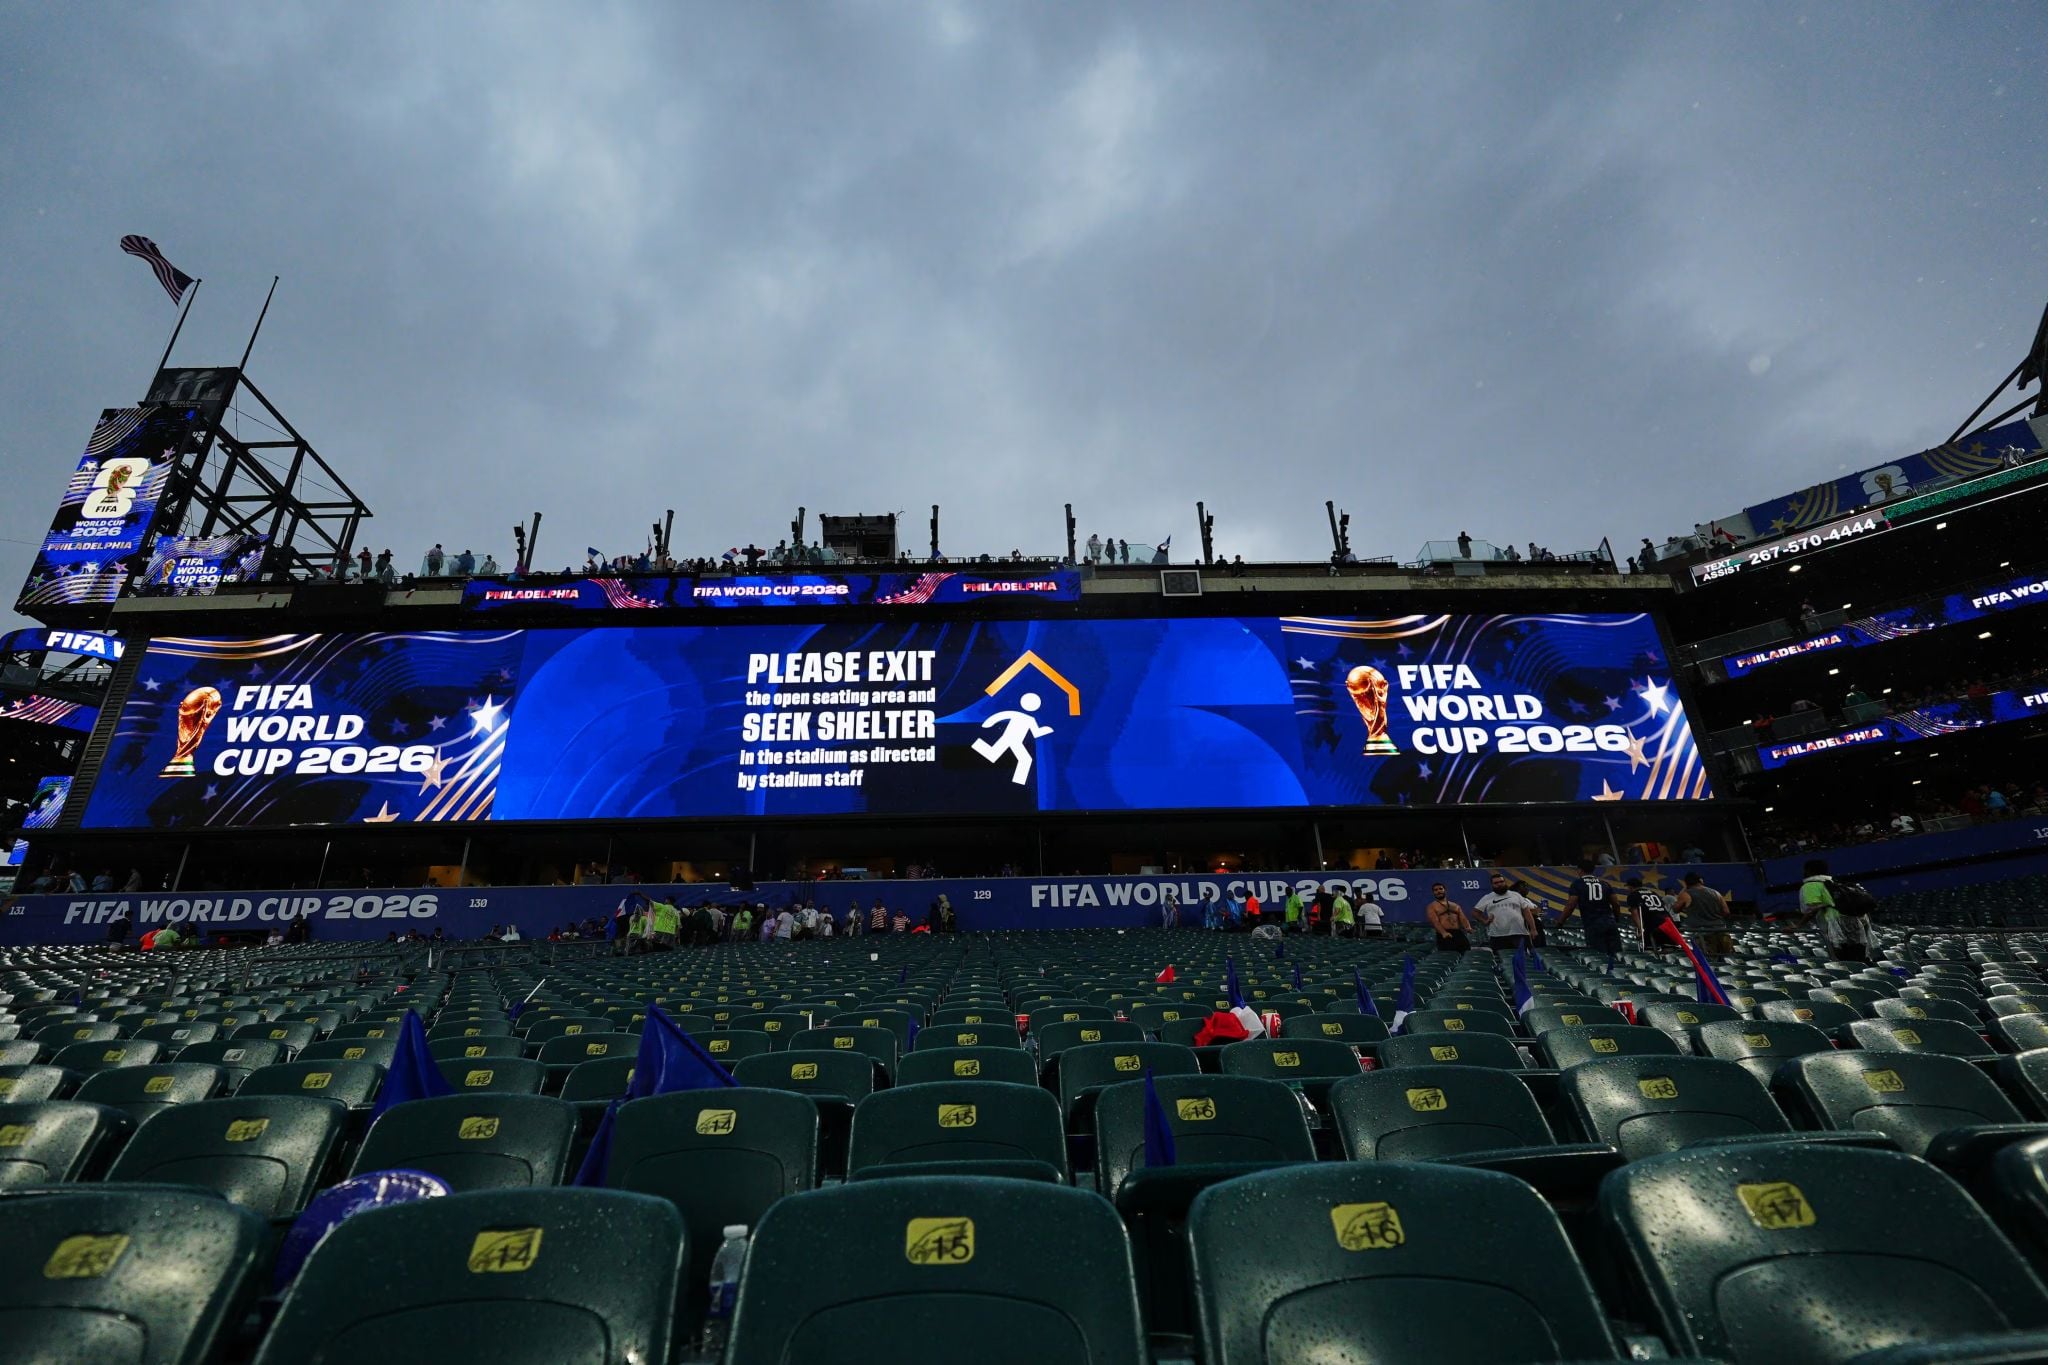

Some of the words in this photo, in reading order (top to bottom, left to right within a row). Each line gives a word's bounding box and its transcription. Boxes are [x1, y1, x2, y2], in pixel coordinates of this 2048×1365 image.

[95, 505, 117, 513] FIFA
[70, 526, 123, 537] 2026
[47, 541, 133, 551] PHILADELPHIA
[1749, 518, 1877, 566] 267-570-4444
[177, 566, 218, 575] WORLD
[180, 558, 204, 566] FIFA
[1704, 558, 1732, 571] TEXT
[173, 575, 197, 584] CUP
[1702, 563, 1742, 582] ASSIST
[485, 589, 579, 600] PHILADELPHIA
[693, 587, 722, 597] FIFA
[723, 586, 772, 596] WORLD
[773, 585, 800, 595] CUP
[801, 584, 849, 595] 2026
[963, 581, 1058, 592] PHILADELPHIA
[1972, 591, 2014, 609] FIFA
[47, 631, 106, 654] FIFA
[1736, 634, 1843, 669] PHILADELPHIA
[747, 651, 861, 684] PLEASE
[868, 650, 936, 682] EXIT
[1397, 664, 1482, 690] FIFA
[234, 684, 313, 711] FIFA
[745, 690, 771, 706] the
[773, 692, 811, 708] open
[812, 689, 869, 707] seating
[871, 690, 906, 704] area
[908, 687, 936, 703] and
[1402, 694, 1543, 722] WORLD
[227, 714, 364, 743] WORLD
[742, 711, 812, 742] SEEK
[817, 709, 936, 741] SHELTER
[1412, 727, 1489, 755] CUP
[1497, 725, 1630, 753] 2026
[1771, 727, 1885, 760] PHILADELPHIA
[213, 747, 292, 777] CUP
[297, 745, 436, 775] 2026
[757, 748, 783, 765] the
[785, 747, 848, 765] stadium
[850, 750, 868, 763] as
[870, 745, 936, 763] directed
[738, 771, 757, 791] by
[759, 771, 822, 788] stadium
[824, 769, 864, 787] staff
[1031, 883, 1101, 908] FIFA
[1104, 881, 1220, 906] WORLD
[1226, 880, 1291, 904] CUP
[1461, 880, 1480, 890] 128
[1586, 882, 1603, 901] 10
[469, 898, 488, 908] 130
[973, 890, 992, 900] 129
[1641, 894, 1662, 908] 30
[9, 906, 26, 916] 131
[64, 901, 131, 924] FIFA
[140, 899, 252, 923] WORLD
[257, 897, 321, 921] CUP
[325, 895, 438, 919] 2026
[802, 1069, 816, 1078] 14
[964, 1065, 978, 1074] 15
[1125, 1061, 1140, 1070] 16
[1652, 1084, 1676, 1097] 18
[1421, 1095, 1441, 1108] 17
[953, 1110, 974, 1125] 15
[1192, 1105, 1214, 1118] 16
[712, 1119, 732, 1132] 14
[1766, 1199, 1801, 1223] 17
[1360, 1220, 1400, 1246] 16
[497, 1243, 532, 1268] 14
[932, 1235, 970, 1260] 15
